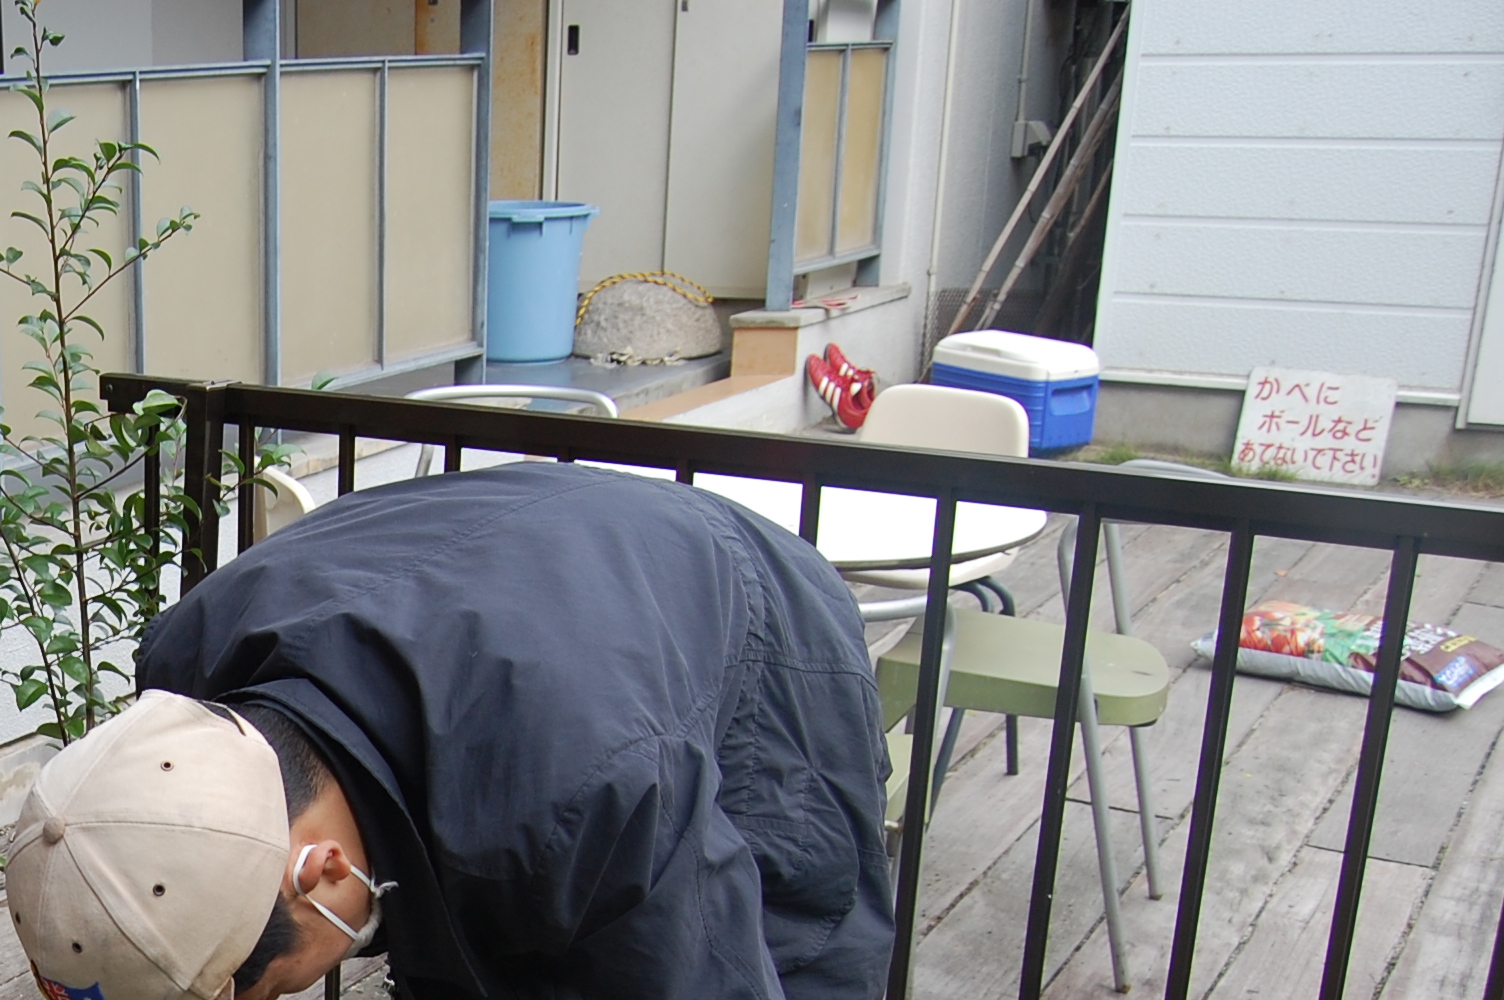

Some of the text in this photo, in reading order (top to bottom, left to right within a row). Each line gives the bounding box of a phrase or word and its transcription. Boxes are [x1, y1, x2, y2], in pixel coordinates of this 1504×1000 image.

[1254, 376, 1340, 405] かべに
[1258, 410, 1383, 442] ボールなど
